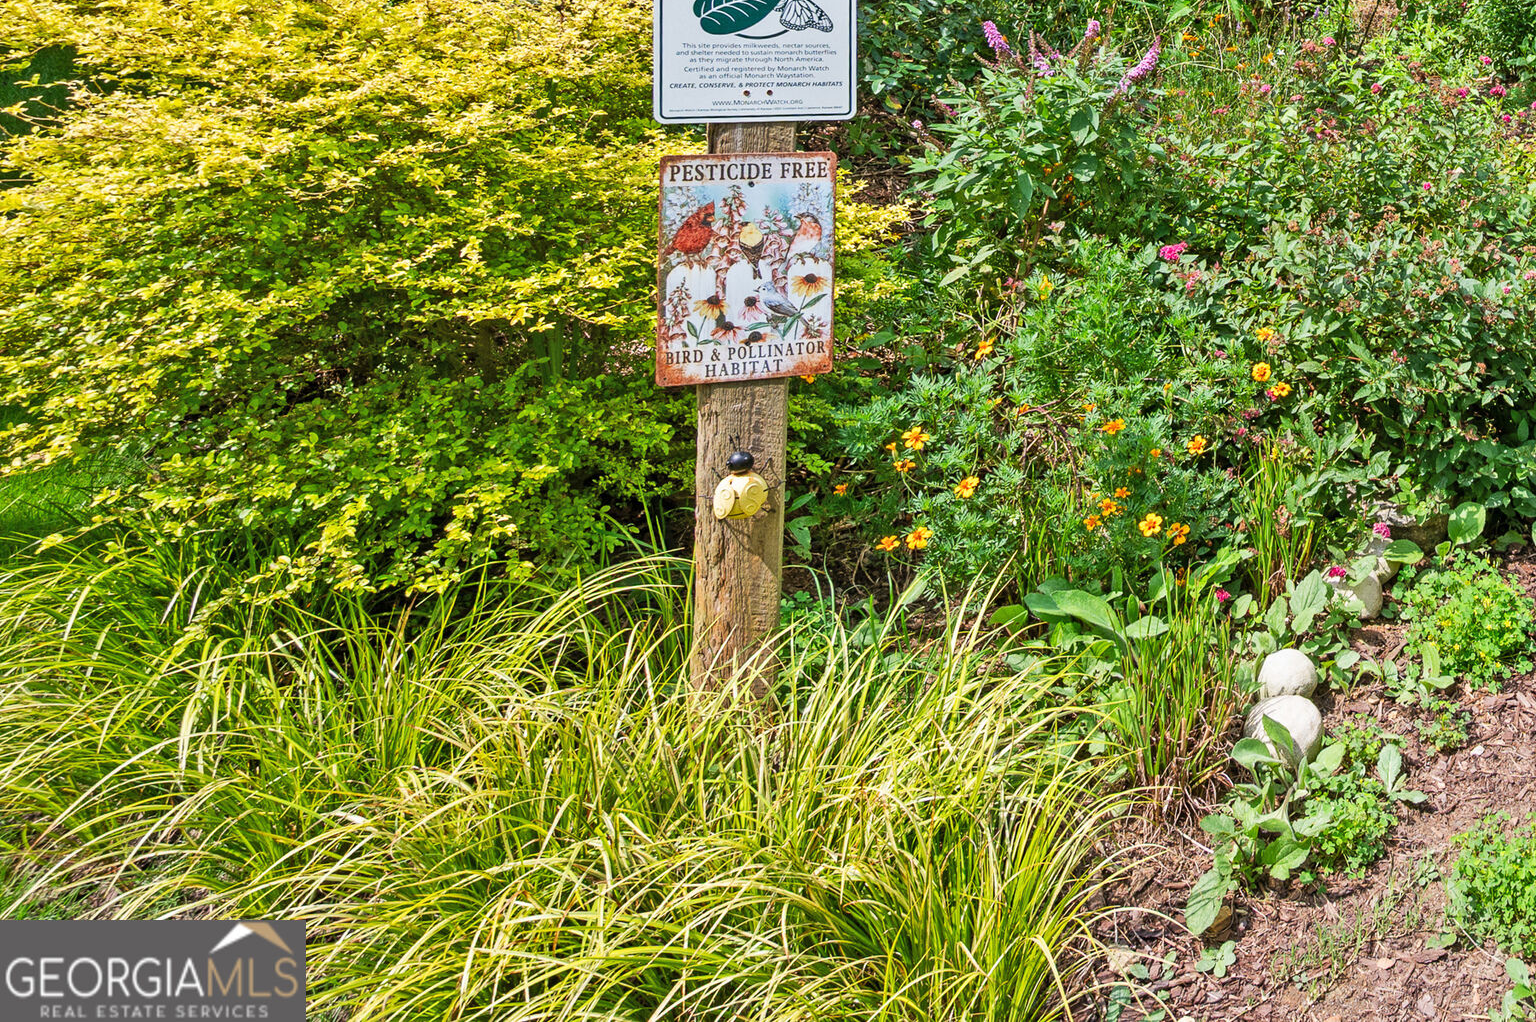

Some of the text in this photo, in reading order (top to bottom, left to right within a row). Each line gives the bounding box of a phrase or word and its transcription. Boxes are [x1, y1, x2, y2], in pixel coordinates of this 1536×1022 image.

[669, 162, 828, 182] PESTICIDE FREE
[666, 341, 826, 365] BIRD & POLLINATOR
[705, 359, 783, 377] HABITAT
